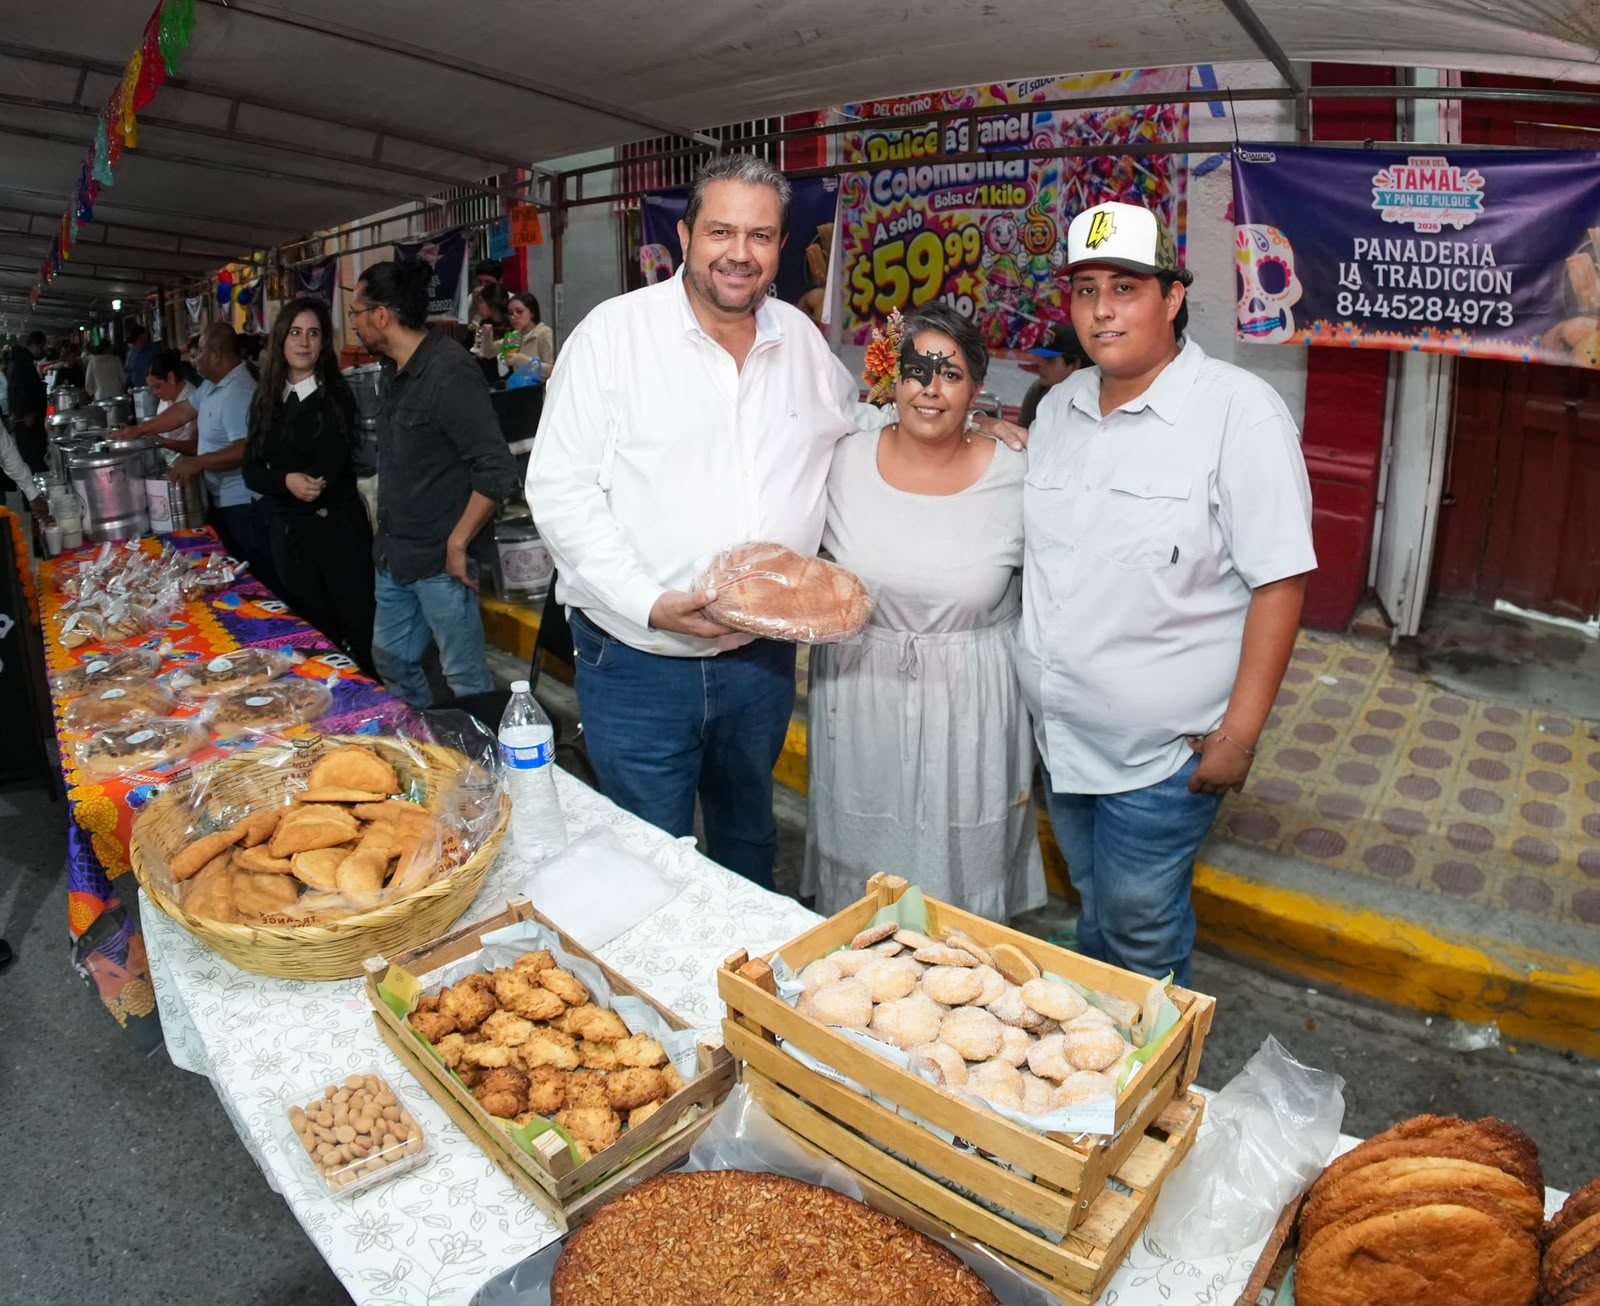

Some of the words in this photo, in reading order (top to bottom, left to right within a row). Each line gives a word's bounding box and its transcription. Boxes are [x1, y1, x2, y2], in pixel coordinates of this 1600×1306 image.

[1018, 80, 1028, 98] El
[873, 102, 890, 116] DEL
[893, 97, 931, 117] CENTRO
[867, 129, 938, 162] Dulce
[958, 112, 1030, 152] ganel
[872, 160, 1025, 201] Colombina
[1392, 168, 1464, 192] TAMAL
[934, 191, 964, 209] Bolsa
[1384, 193, 1392, 204] Y
[1394, 194, 1413, 205] PAN
[1416, 195, 1430, 206] DE
[1431, 196, 1471, 208] PULQUE
[873, 227, 888, 246] A
[889, 208, 923, 240] solo
[1353, 238, 1497, 266] PANADERÍA
[851, 226, 982, 315] $59.99
[1338, 262, 1363, 291] LA
[1373, 265, 1512, 295] TRADICIÓN
[1336, 291, 1514, 327] 8445284973
